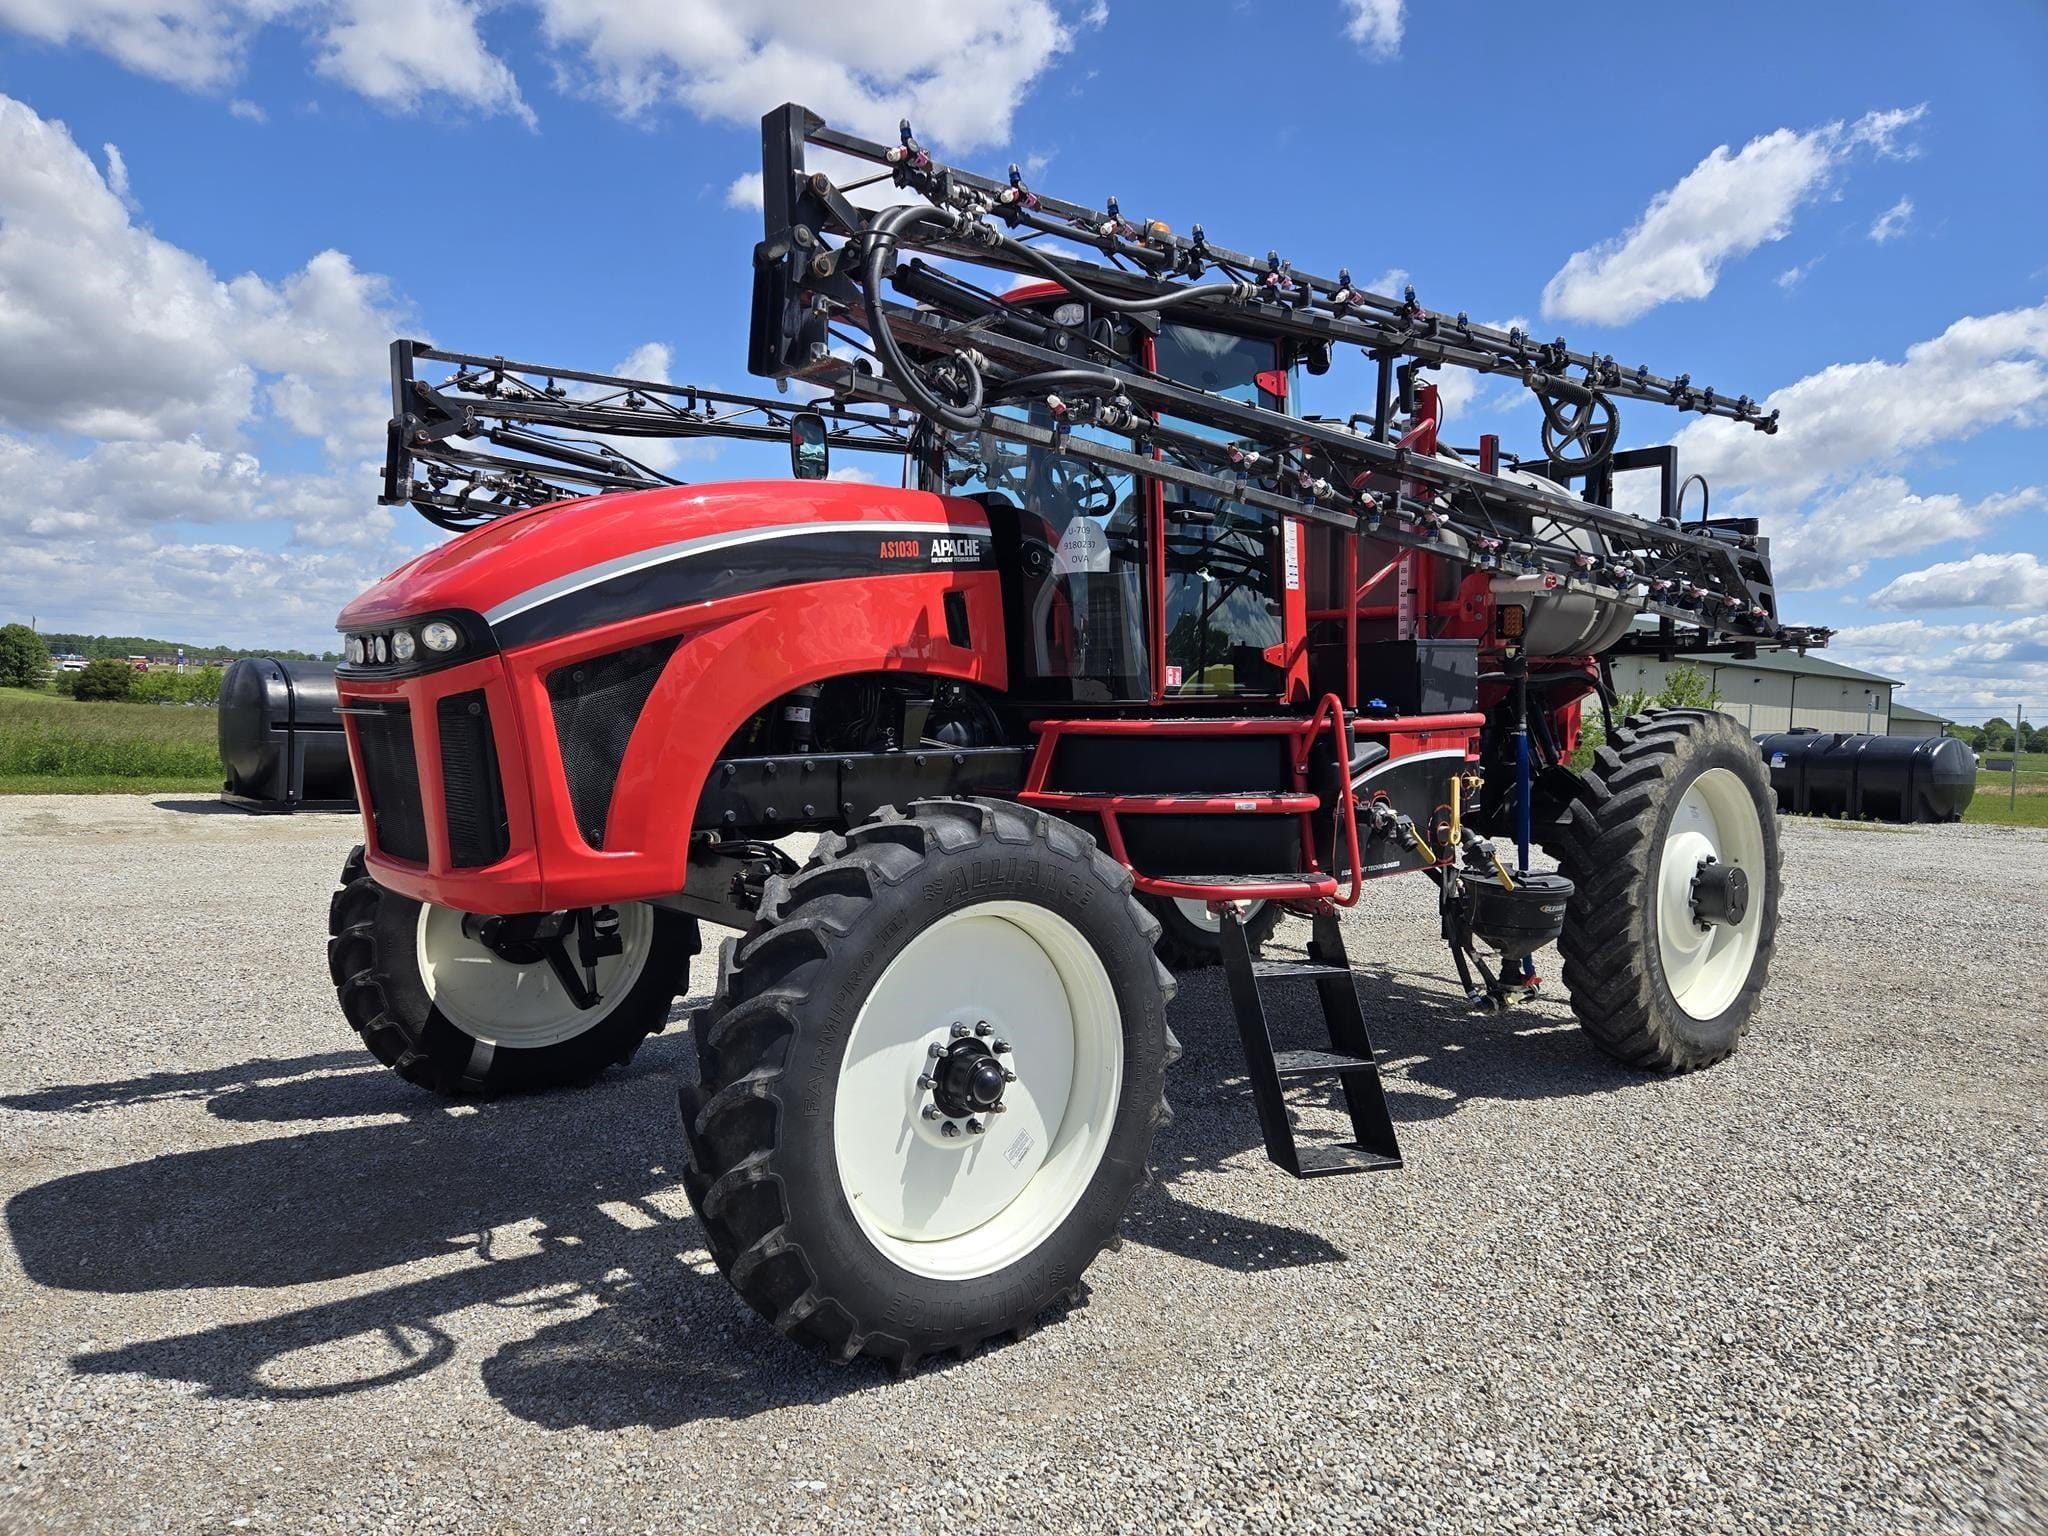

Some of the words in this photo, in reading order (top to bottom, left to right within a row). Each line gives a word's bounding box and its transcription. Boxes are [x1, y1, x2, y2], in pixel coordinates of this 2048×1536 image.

[1068, 526, 1091, 535] U-709
[880, 540, 919, 558] AS1030
[931, 539, 980, 557] APACHE
[1063, 540, 1096, 550] 9180237
[1071, 555, 1090, 564] OVA
[945, 857, 1096, 909] ALLIANCE
